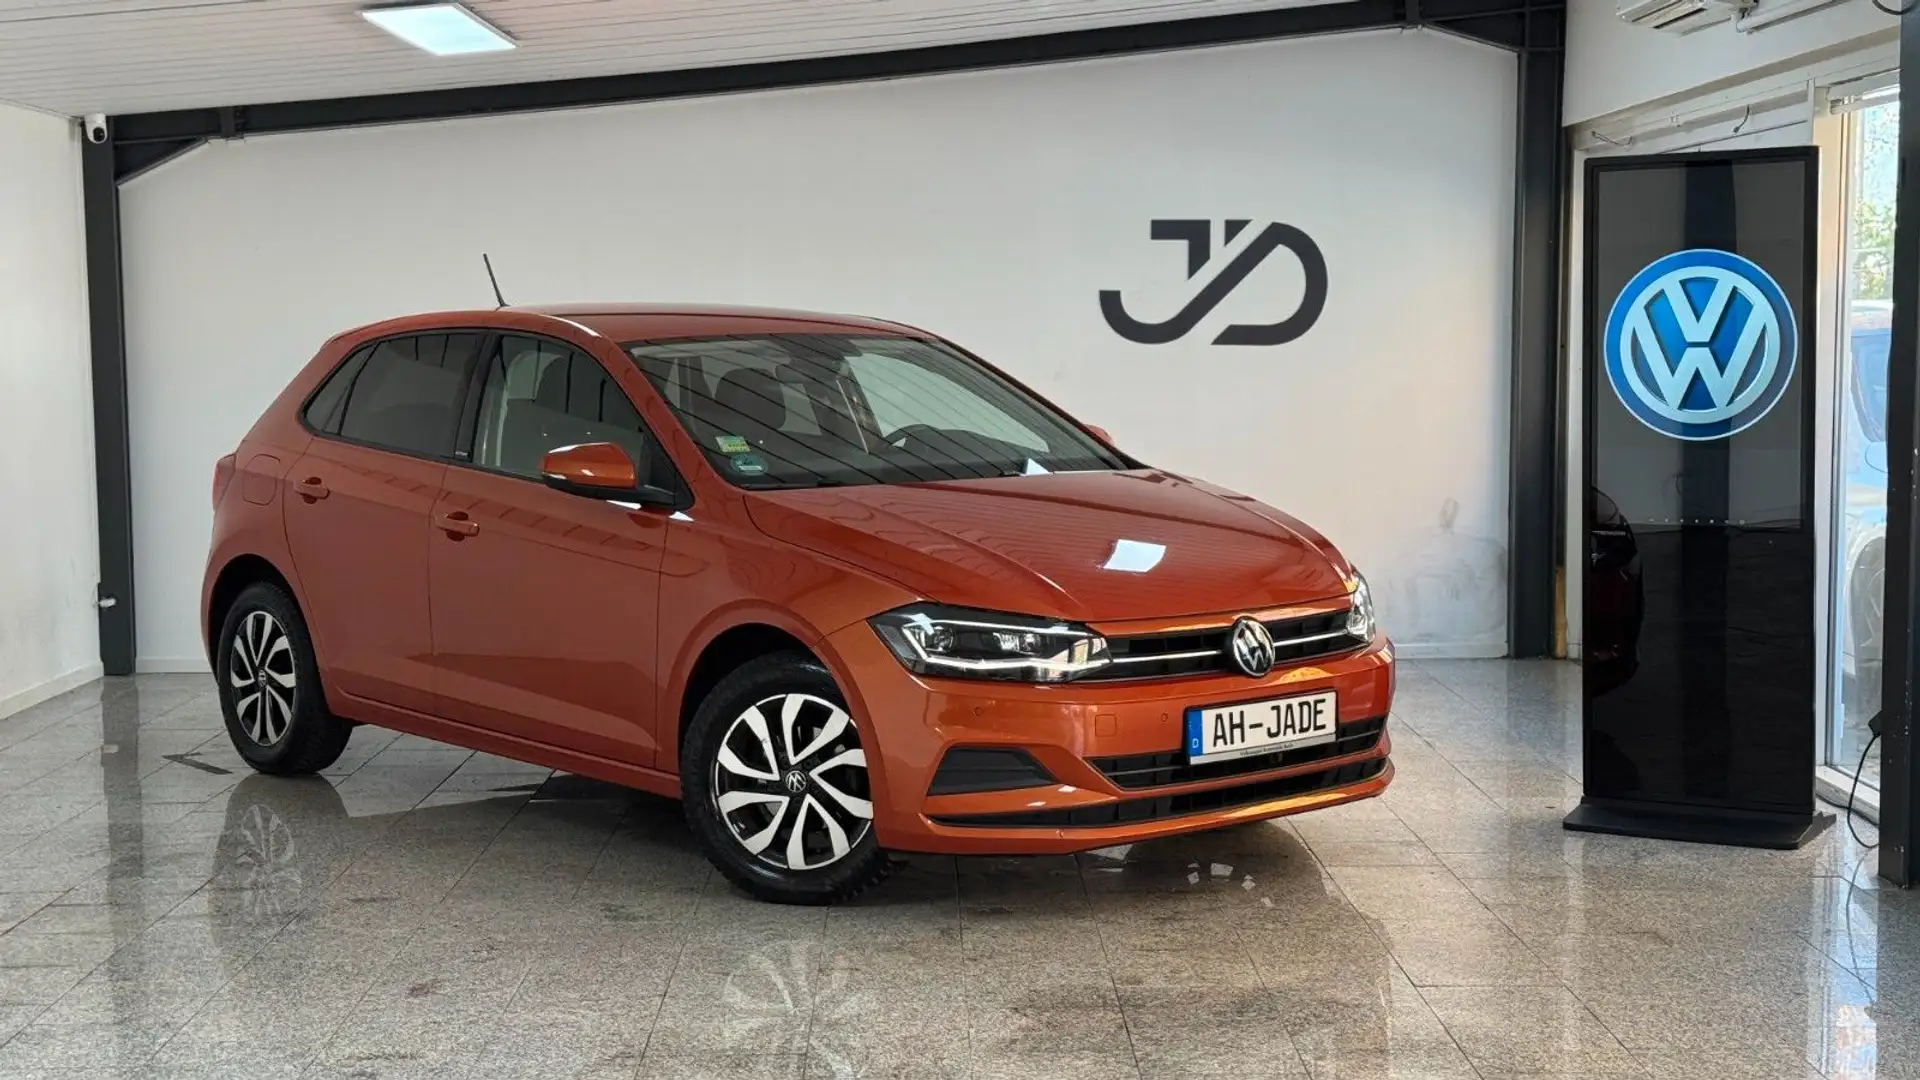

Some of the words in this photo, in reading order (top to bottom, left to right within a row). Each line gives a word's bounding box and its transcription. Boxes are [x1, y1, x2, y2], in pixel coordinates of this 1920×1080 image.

[1622, 268, 1778, 422] VW
[1192, 738, 1199, 749] D
[1212, 698, 1327, 748] AH-JADE
